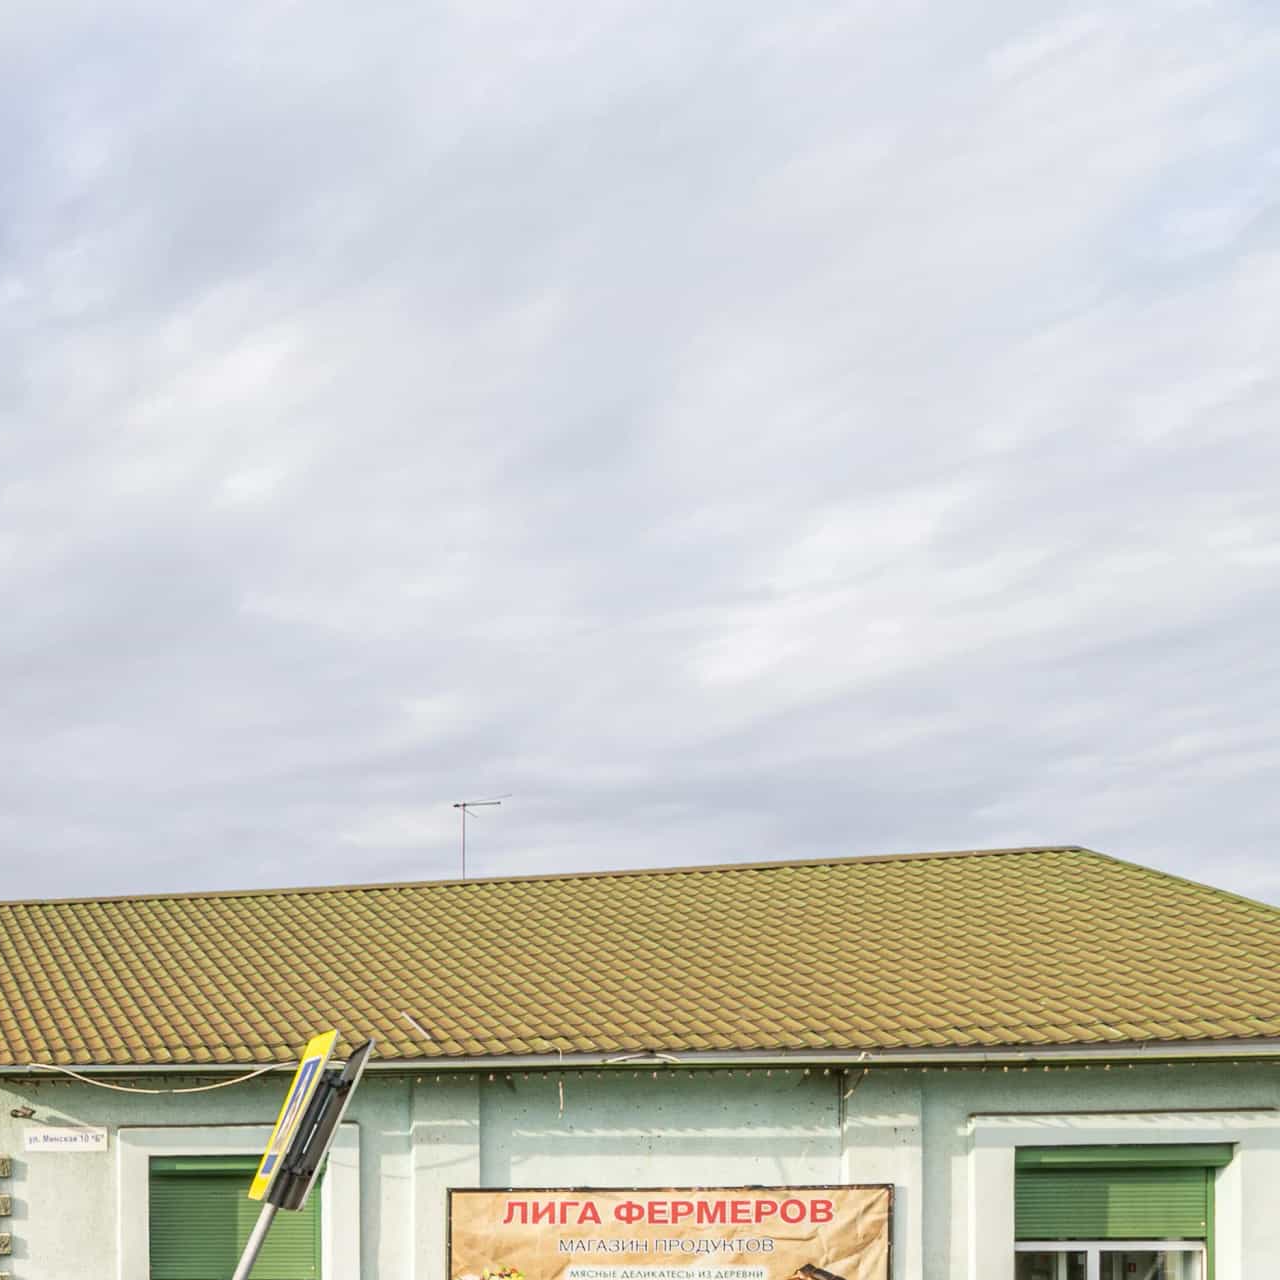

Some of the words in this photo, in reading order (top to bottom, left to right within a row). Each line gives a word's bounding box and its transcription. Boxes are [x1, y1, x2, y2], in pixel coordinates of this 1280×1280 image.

[43, 1134, 78, 1143] Минская
[503, 1201, 602, 1225] ЛИГА
[613, 1199, 834, 1225] ФЕРМЕРОВ
[559, 1238, 648, 1253] МАГАЗИН
[655, 1237, 774, 1255] ПРОДУКТОВ
[570, 1270, 617, 1278] МЯСНЫЕ
[621, 1270, 695, 1279] ДЕЛИКАТЕСЫ
[698, 1270, 712, 1279] ИЗ
[715, 1270, 764, 1279] ДЕРЕВНИ
